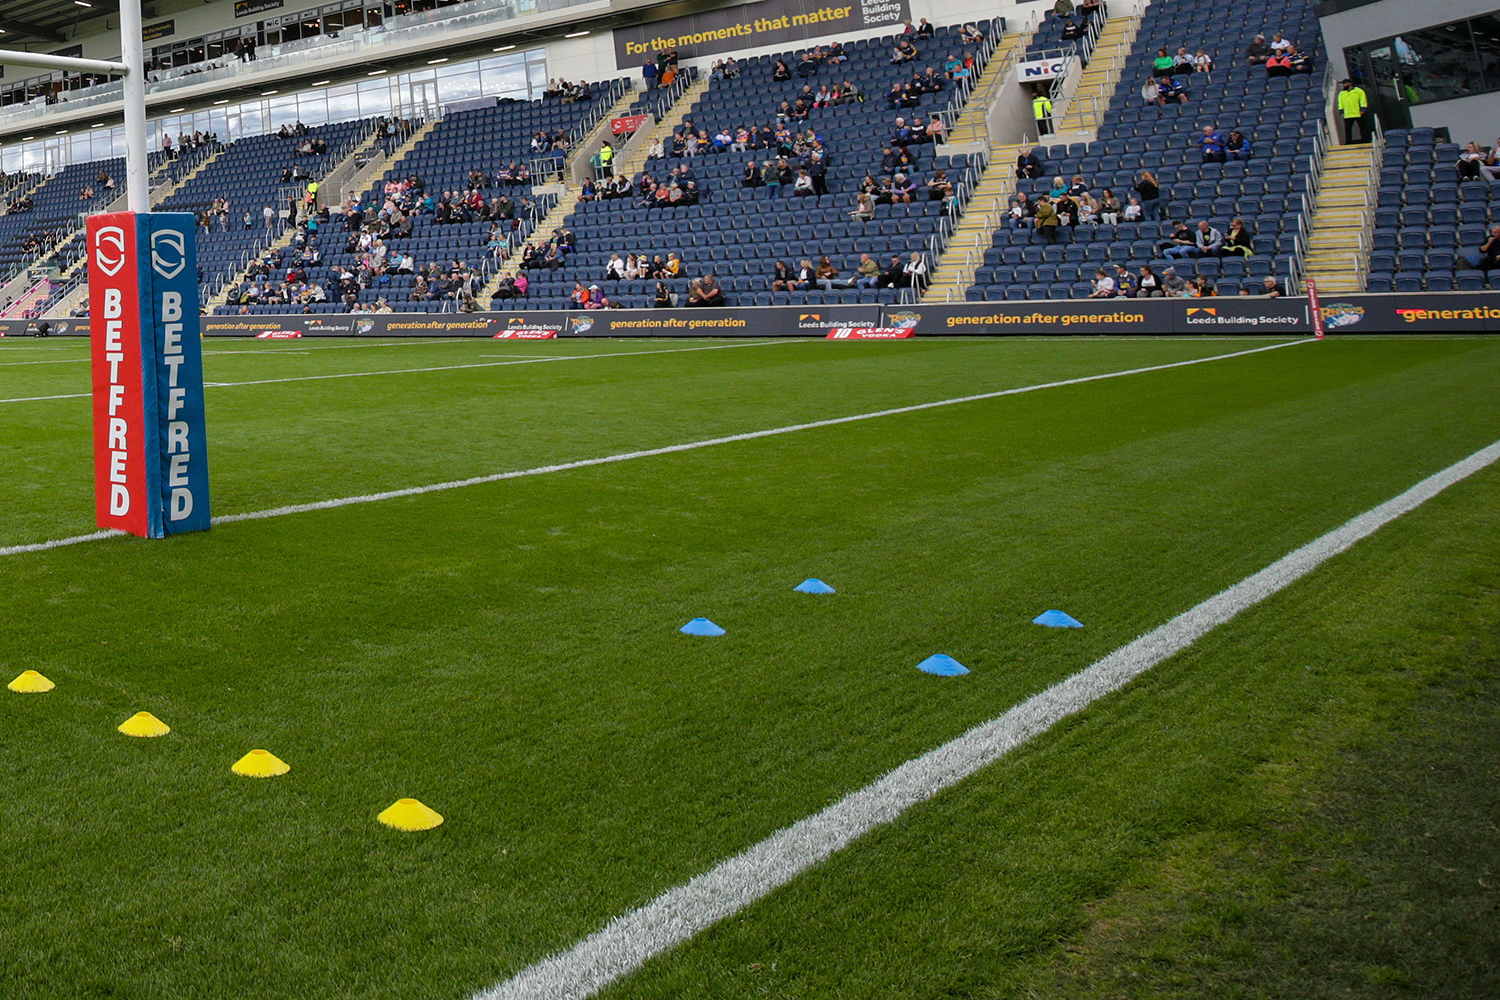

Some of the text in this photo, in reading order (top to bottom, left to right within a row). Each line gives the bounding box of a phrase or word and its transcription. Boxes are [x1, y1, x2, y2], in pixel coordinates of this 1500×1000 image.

[264, 0, 281, 10] Society
[862, 2, 901, 16] Building
[864, 11, 901, 25] Society
[625, 4, 852, 56] For the moments that matter
[947, 311, 1145, 327] generation after generation
[1217, 315, 1258, 326] Building
[1259, 315, 1299, 325] Society
[1402, 305, 1500, 323] generatio
[206, 321, 281, 331] generation after generation
[387, 320, 489, 331] generation after generation
[523, 324, 542, 332] Building
[610, 317, 746, 330] generation after generation
[799, 320, 875, 329] Leeds Building Society
[833, 327, 906, 339] 10 GLEN'S
[103, 288, 130, 517] BETFRED
[161, 290, 194, 522] BETFRED
